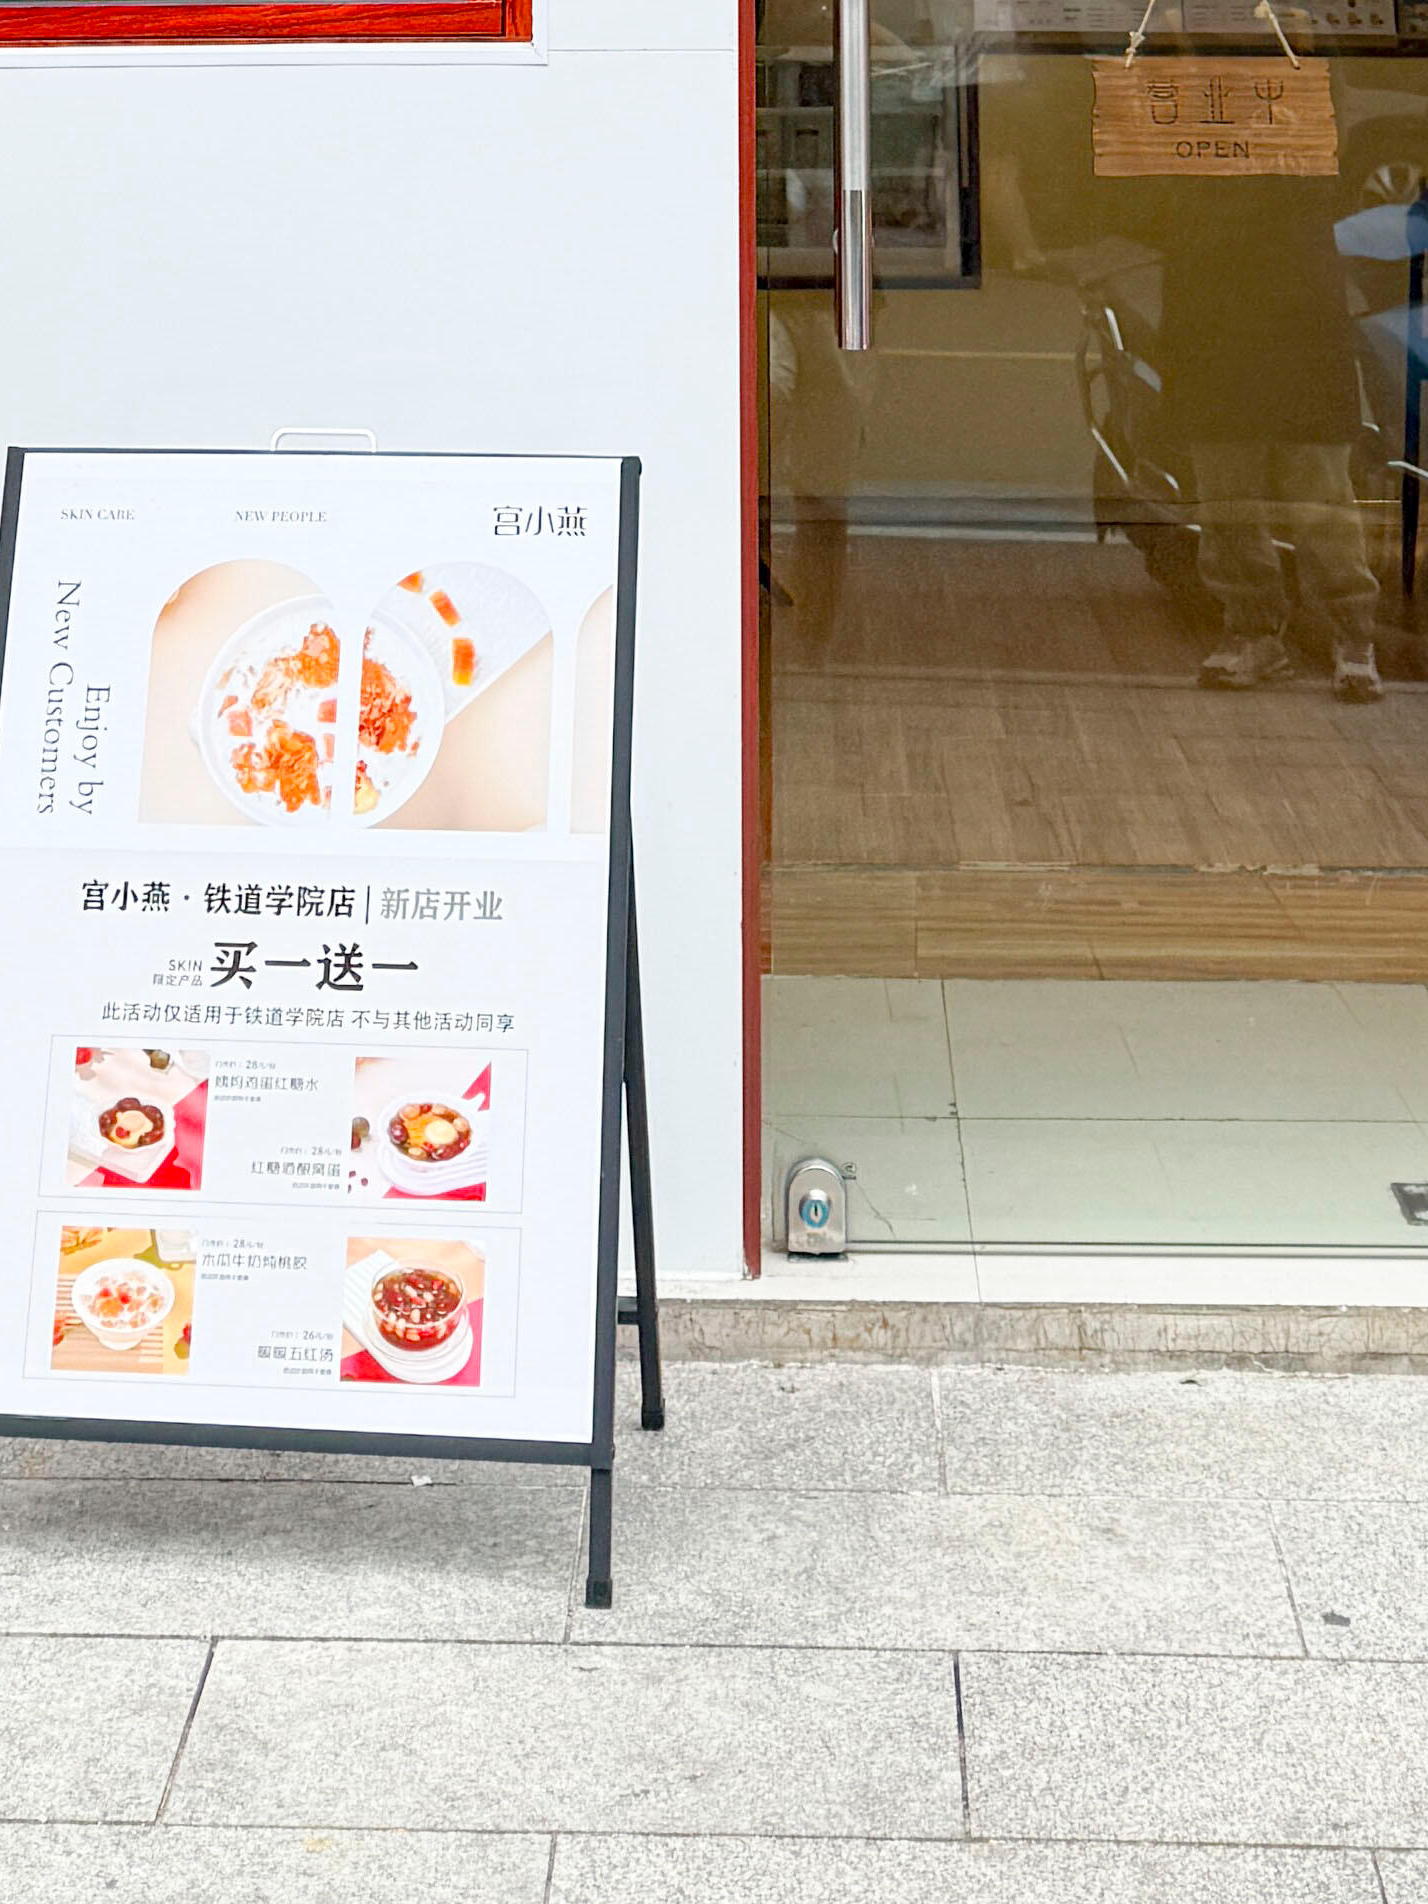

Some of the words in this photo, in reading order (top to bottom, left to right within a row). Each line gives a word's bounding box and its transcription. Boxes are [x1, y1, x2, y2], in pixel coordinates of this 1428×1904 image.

[1147, 76, 1285, 124] 营业中
[1175, 140, 1250, 159] OPEN
[60, 508, 93, 520] SKIN
[97, 508, 136, 521] CARE
[235, 510, 267, 522] NEW
[271, 510, 328, 523] PEOPLE
[492, 505, 588, 538] 宫小燕
[53, 579, 82, 650] New
[36, 661, 75, 814] Customers
[73, 683, 111, 769] Enjoy
[69, 780, 104, 815] by
[380, 887, 504, 921] 新店开业
[168, 959, 203, 972] SKIN
[210, 941, 419, 991] 买一送一
[101, 1001, 344, 1029] 此活动仅适用于铁道学院店
[351, 1008, 515, 1034] 不与其他活动同享
